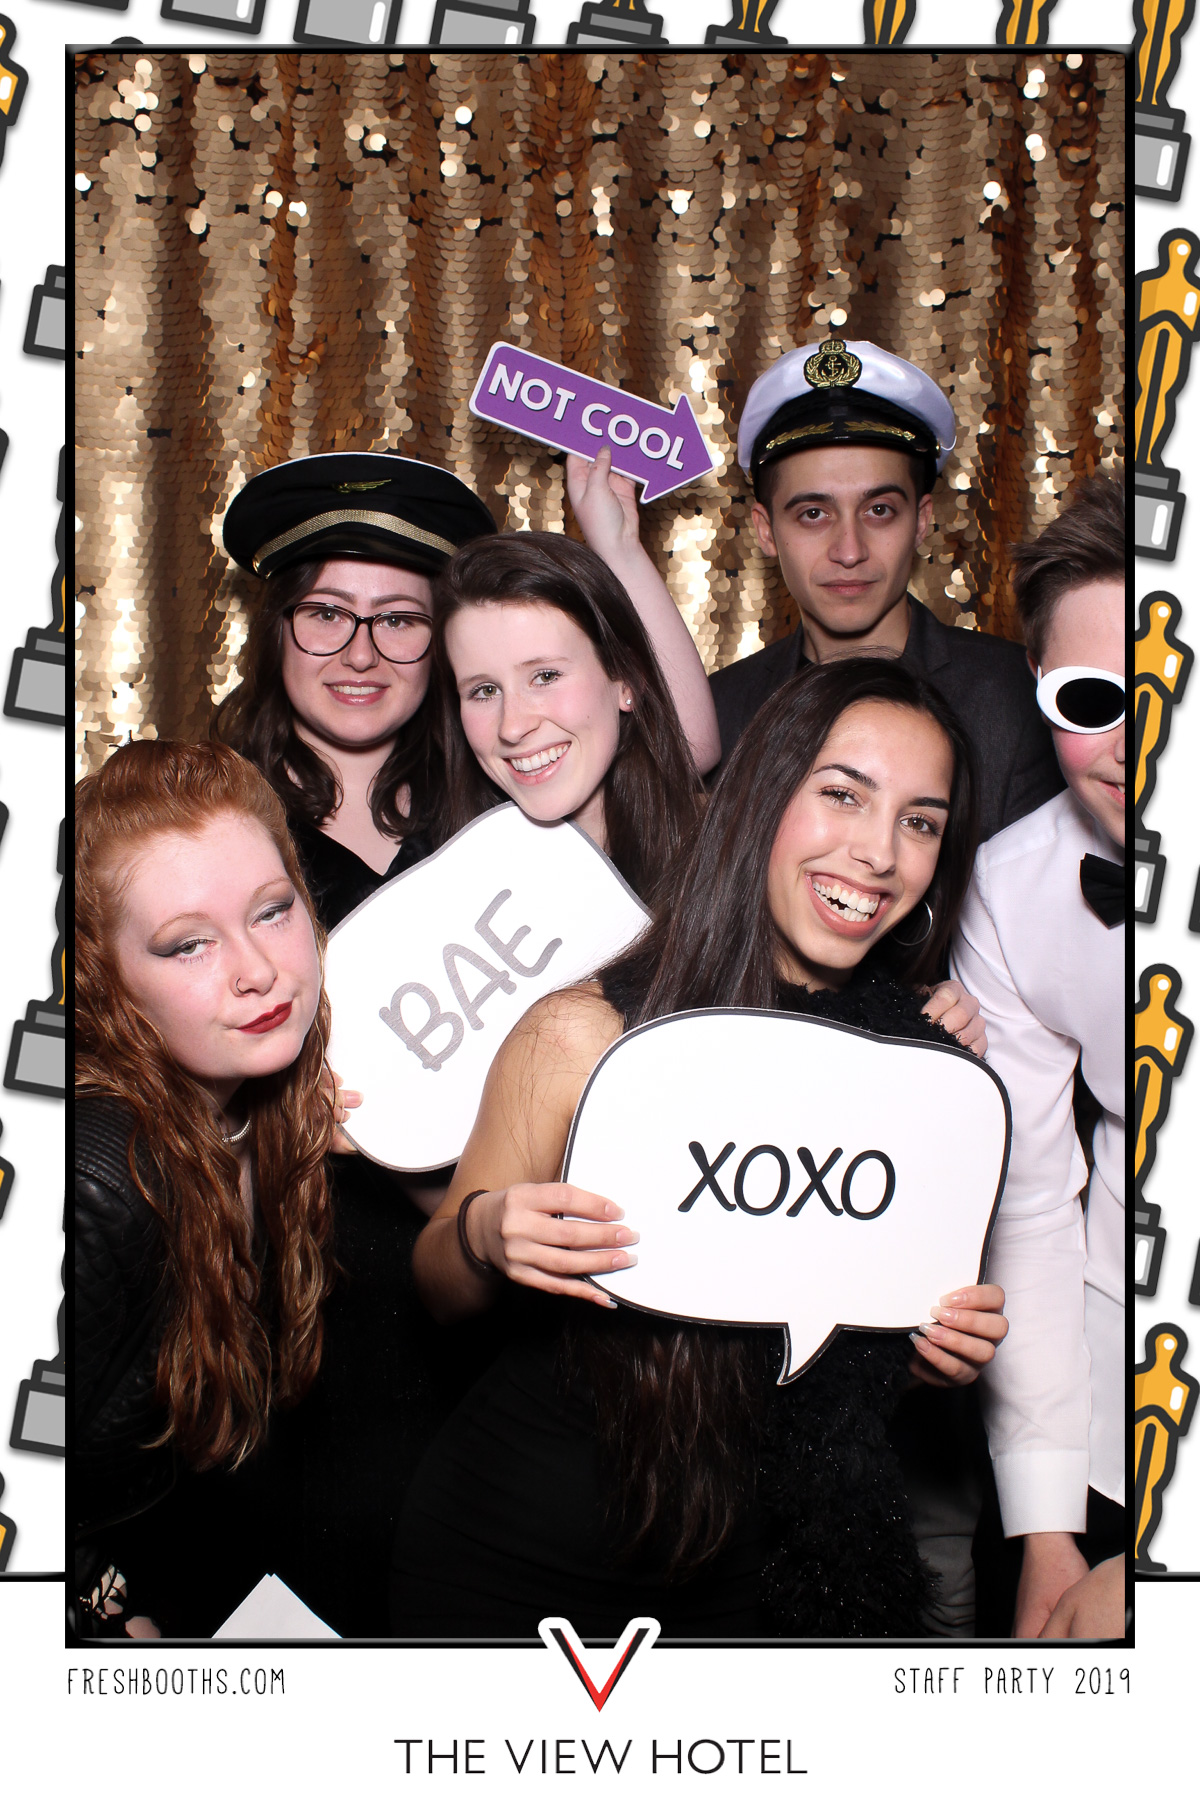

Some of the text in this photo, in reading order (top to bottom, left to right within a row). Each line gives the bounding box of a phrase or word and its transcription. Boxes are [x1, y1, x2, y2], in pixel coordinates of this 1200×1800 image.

[488, 363, 684, 470] NOT COOL
[378, 888, 563, 1072] BAE
[677, 1140, 896, 1221] XOXO
